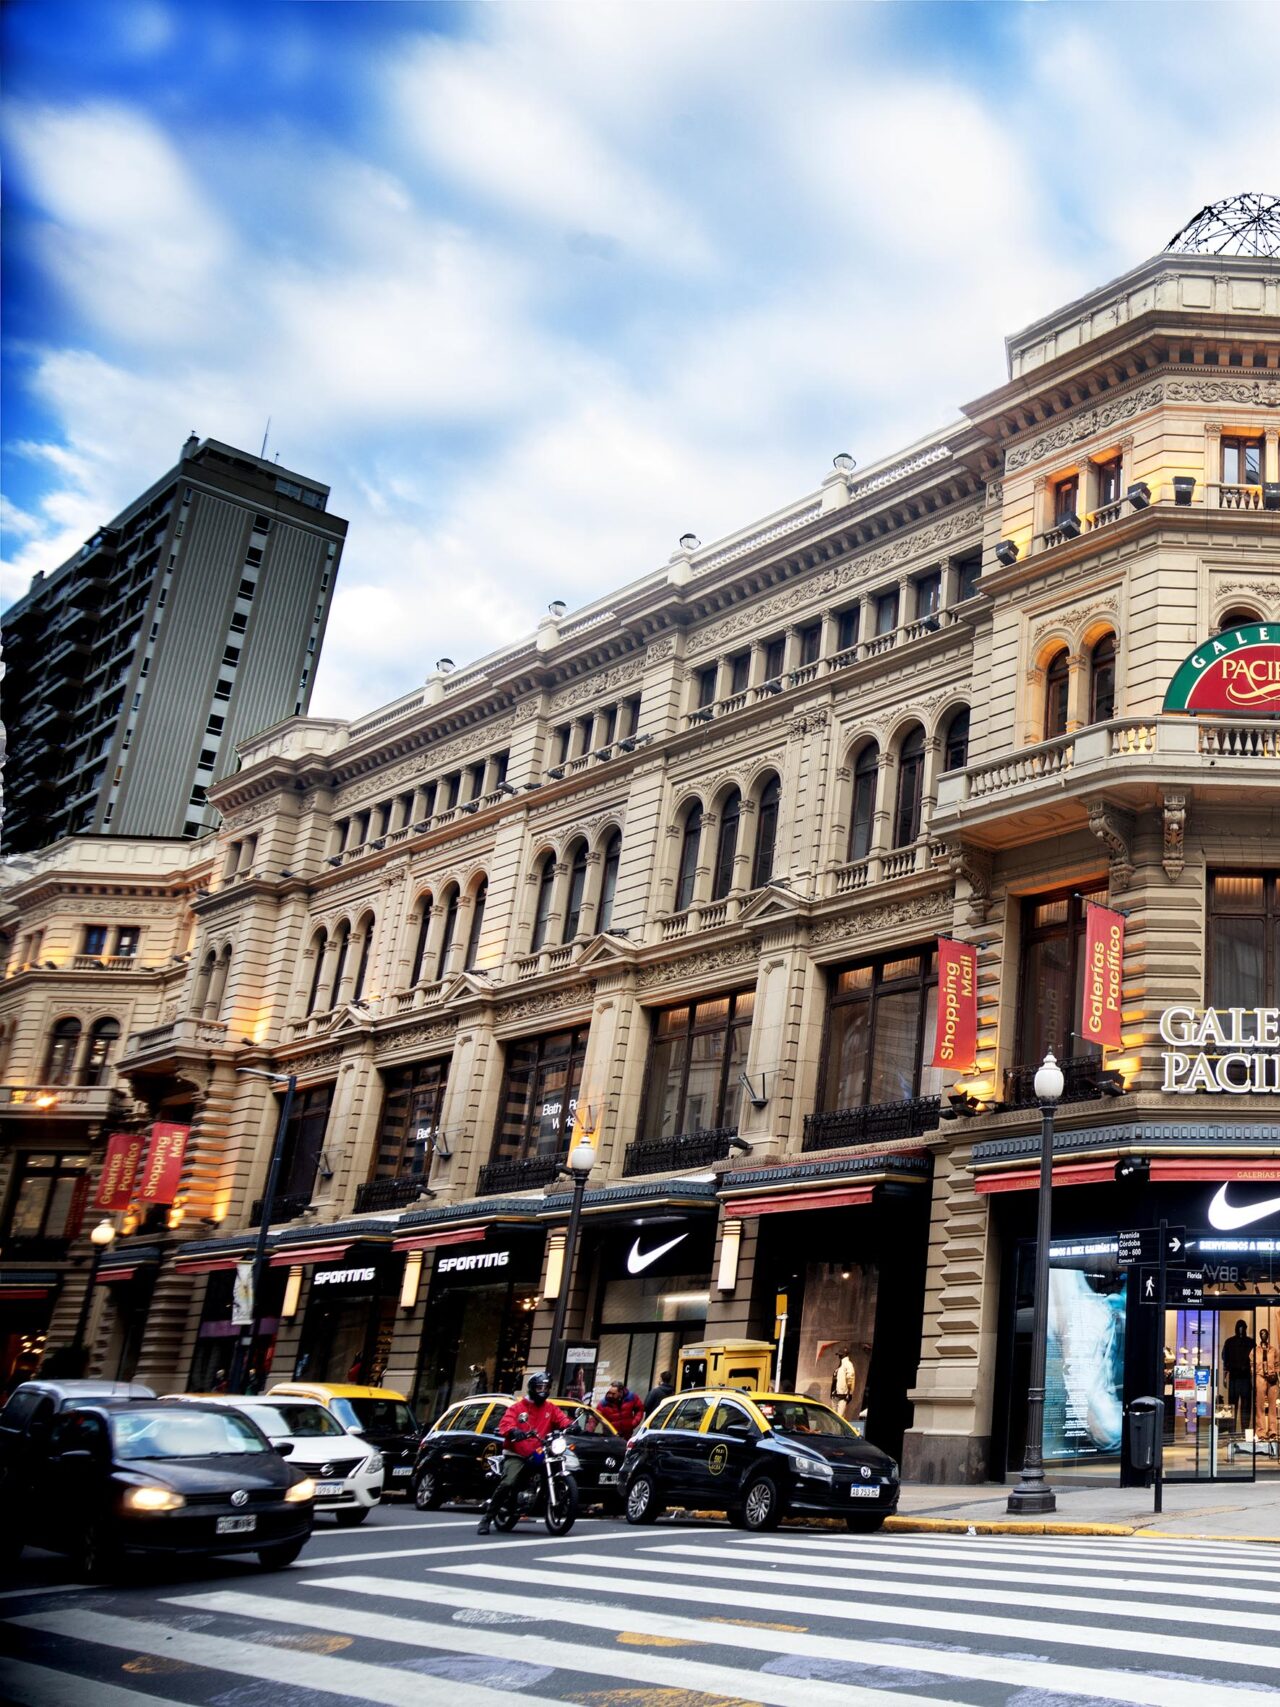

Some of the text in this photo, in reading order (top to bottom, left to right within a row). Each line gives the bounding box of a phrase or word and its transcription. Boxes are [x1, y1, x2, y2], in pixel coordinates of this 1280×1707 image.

[960, 955, 973, 997] Mall
[1106, 925, 1121, 1012] Pacífico
[1088, 941, 1105, 1033] Galerías
[940, 962, 961, 1060] Shopping
[542, 1102, 562, 1116] Bath
[168, 1131, 186, 1158] Mall
[143, 1136, 171, 1197] Shopping
[1132, 1248, 1141, 1256] 600
[1199, 1240, 1249, 1251] BIENVENIDOS
[1249, 1241, 1256, 1250] A
[438, 1251, 510, 1272] SPORTING
[313, 1267, 376, 1285] SPORTING
[1186, 1271, 1202, 1279] Florida
[710, 1352, 724, 1371] T
